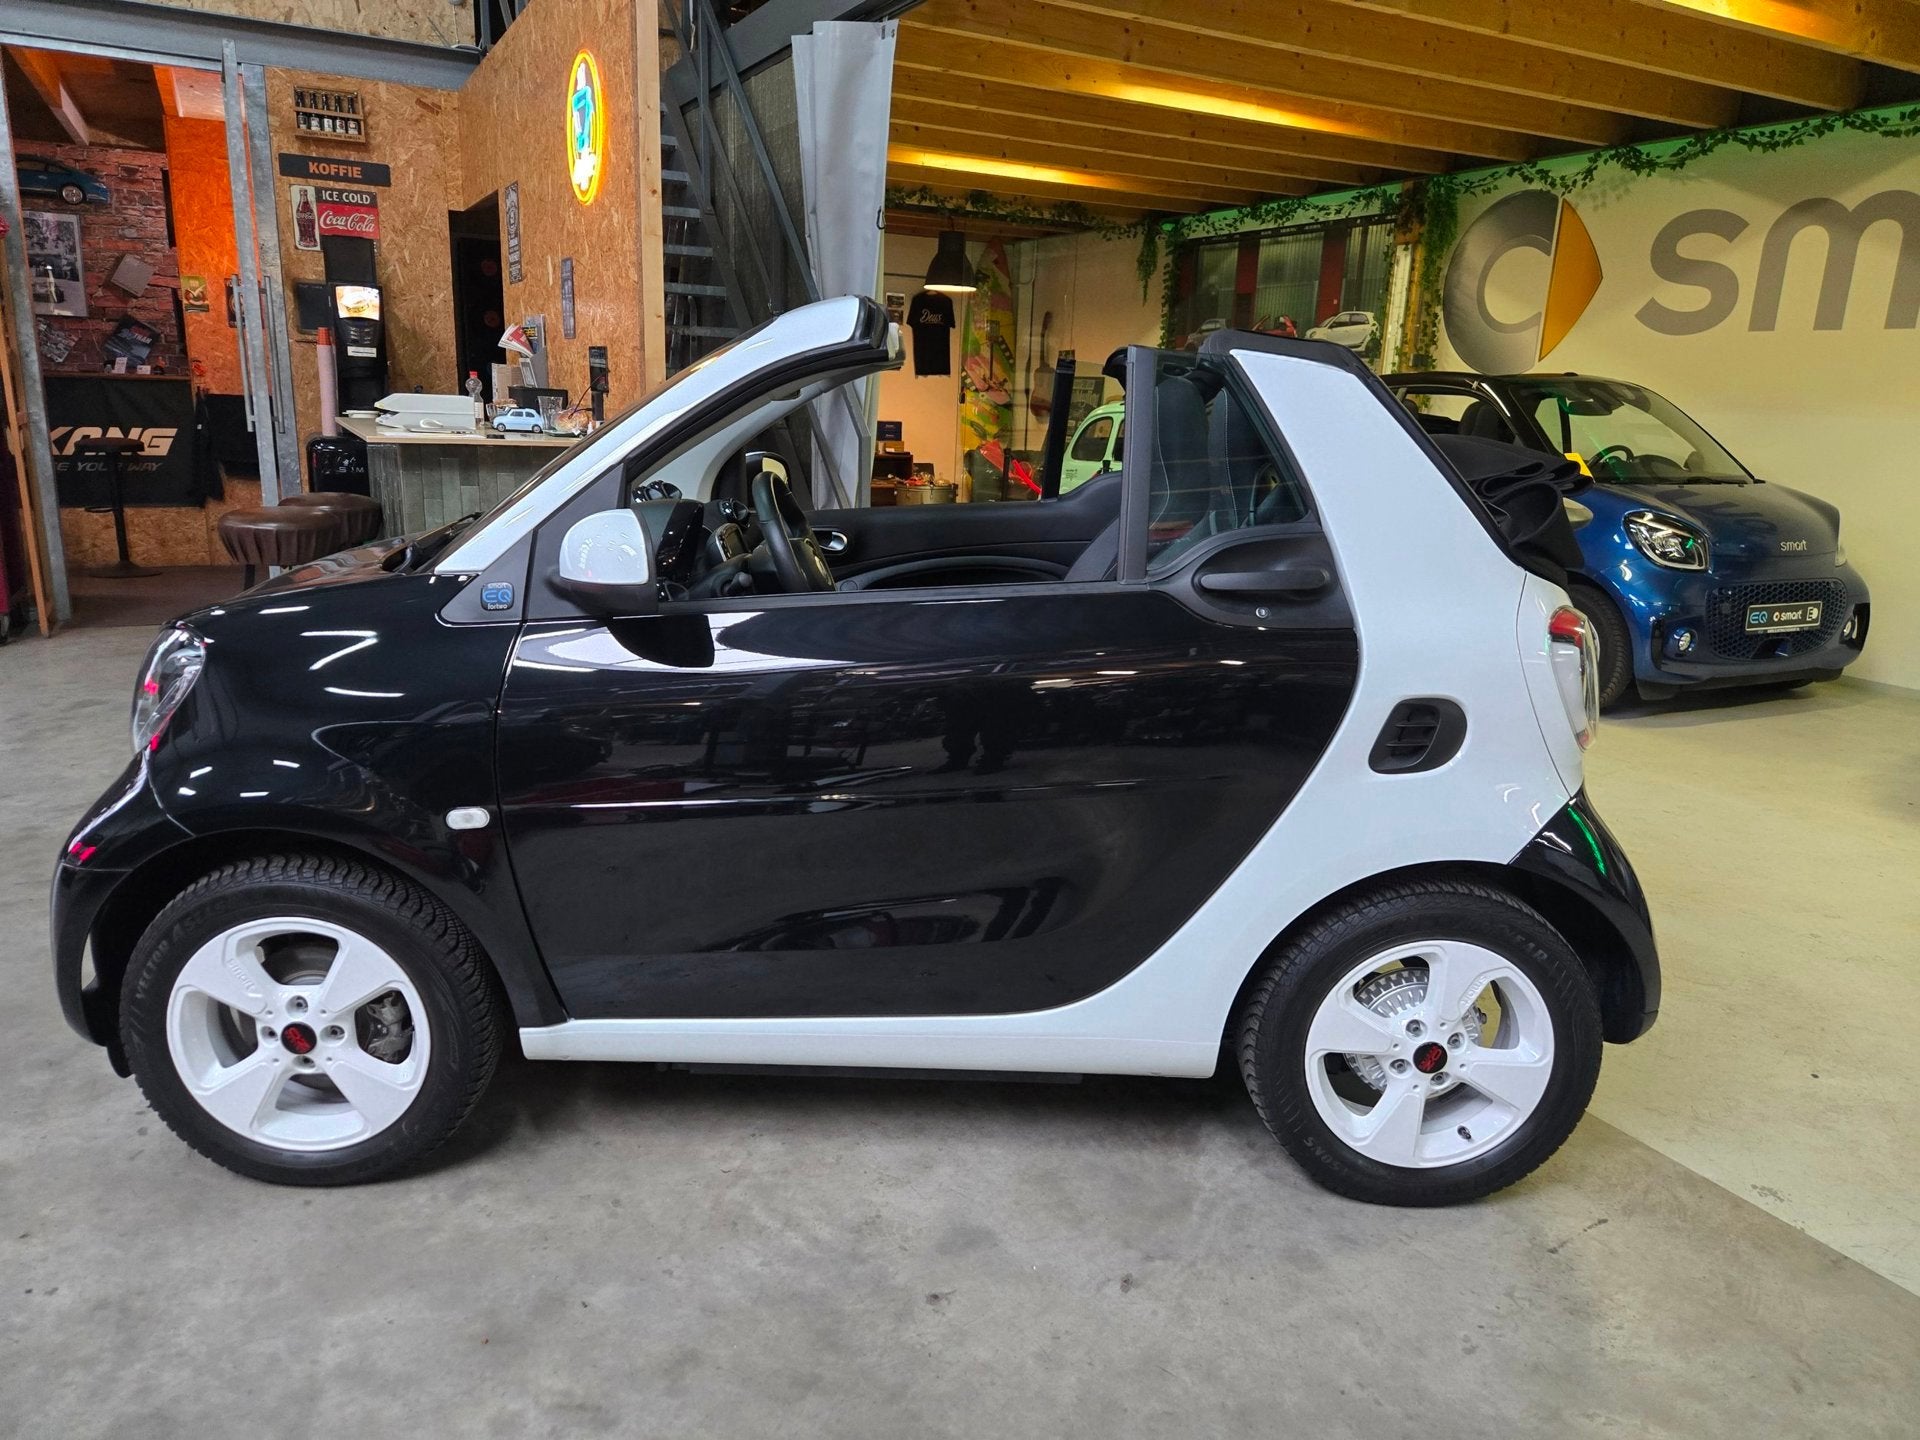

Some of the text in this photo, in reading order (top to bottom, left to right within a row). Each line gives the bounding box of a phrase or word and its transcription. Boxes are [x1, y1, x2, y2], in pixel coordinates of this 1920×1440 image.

[308, 162, 362, 178] KOFFIE
[322, 190, 371, 204] ICE COLD
[320, 210, 375, 232] Coca-Cola
[1780, 540, 1807, 551] smart
[483, 589, 512, 603] EQ
[1750, 611, 1768, 624] EQ
[1780, 610, 1802, 621] smart
